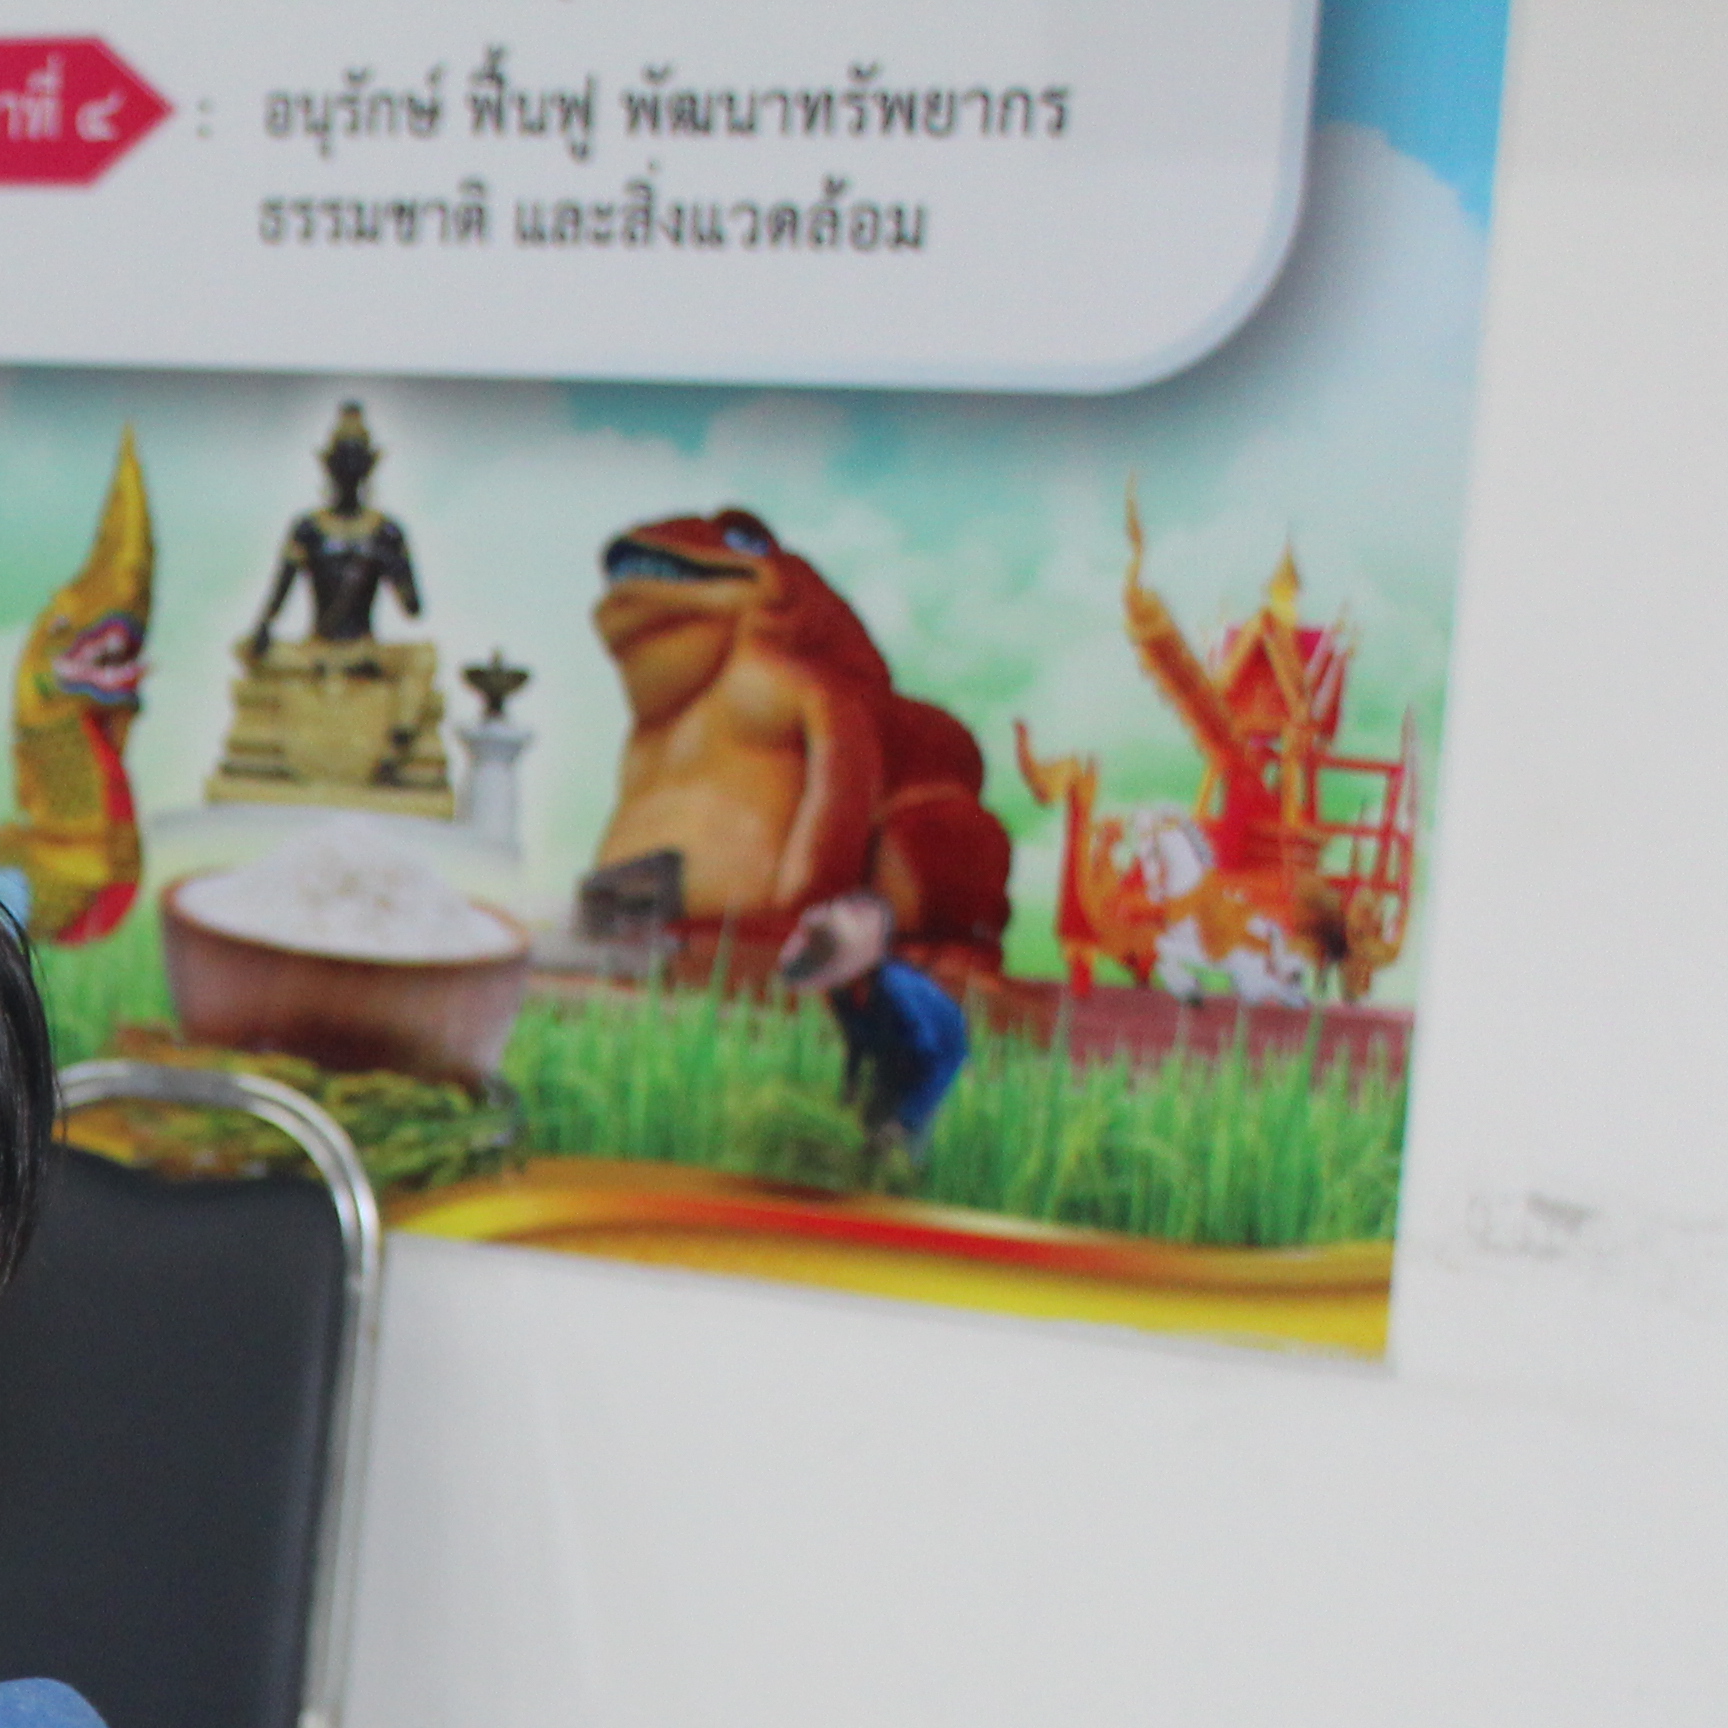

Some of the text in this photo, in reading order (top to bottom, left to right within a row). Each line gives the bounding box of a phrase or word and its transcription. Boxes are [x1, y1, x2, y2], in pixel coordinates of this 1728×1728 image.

[261, 65, 446, 160] อนุรักษ์
[466, 44, 598, 164] ฟื้นฟู
[619, 60, 1073, 141] พัฒนาทรัพยากร
[256, 160, 928, 254] ธรรมชาติ และสิ่งแวดล้อม
